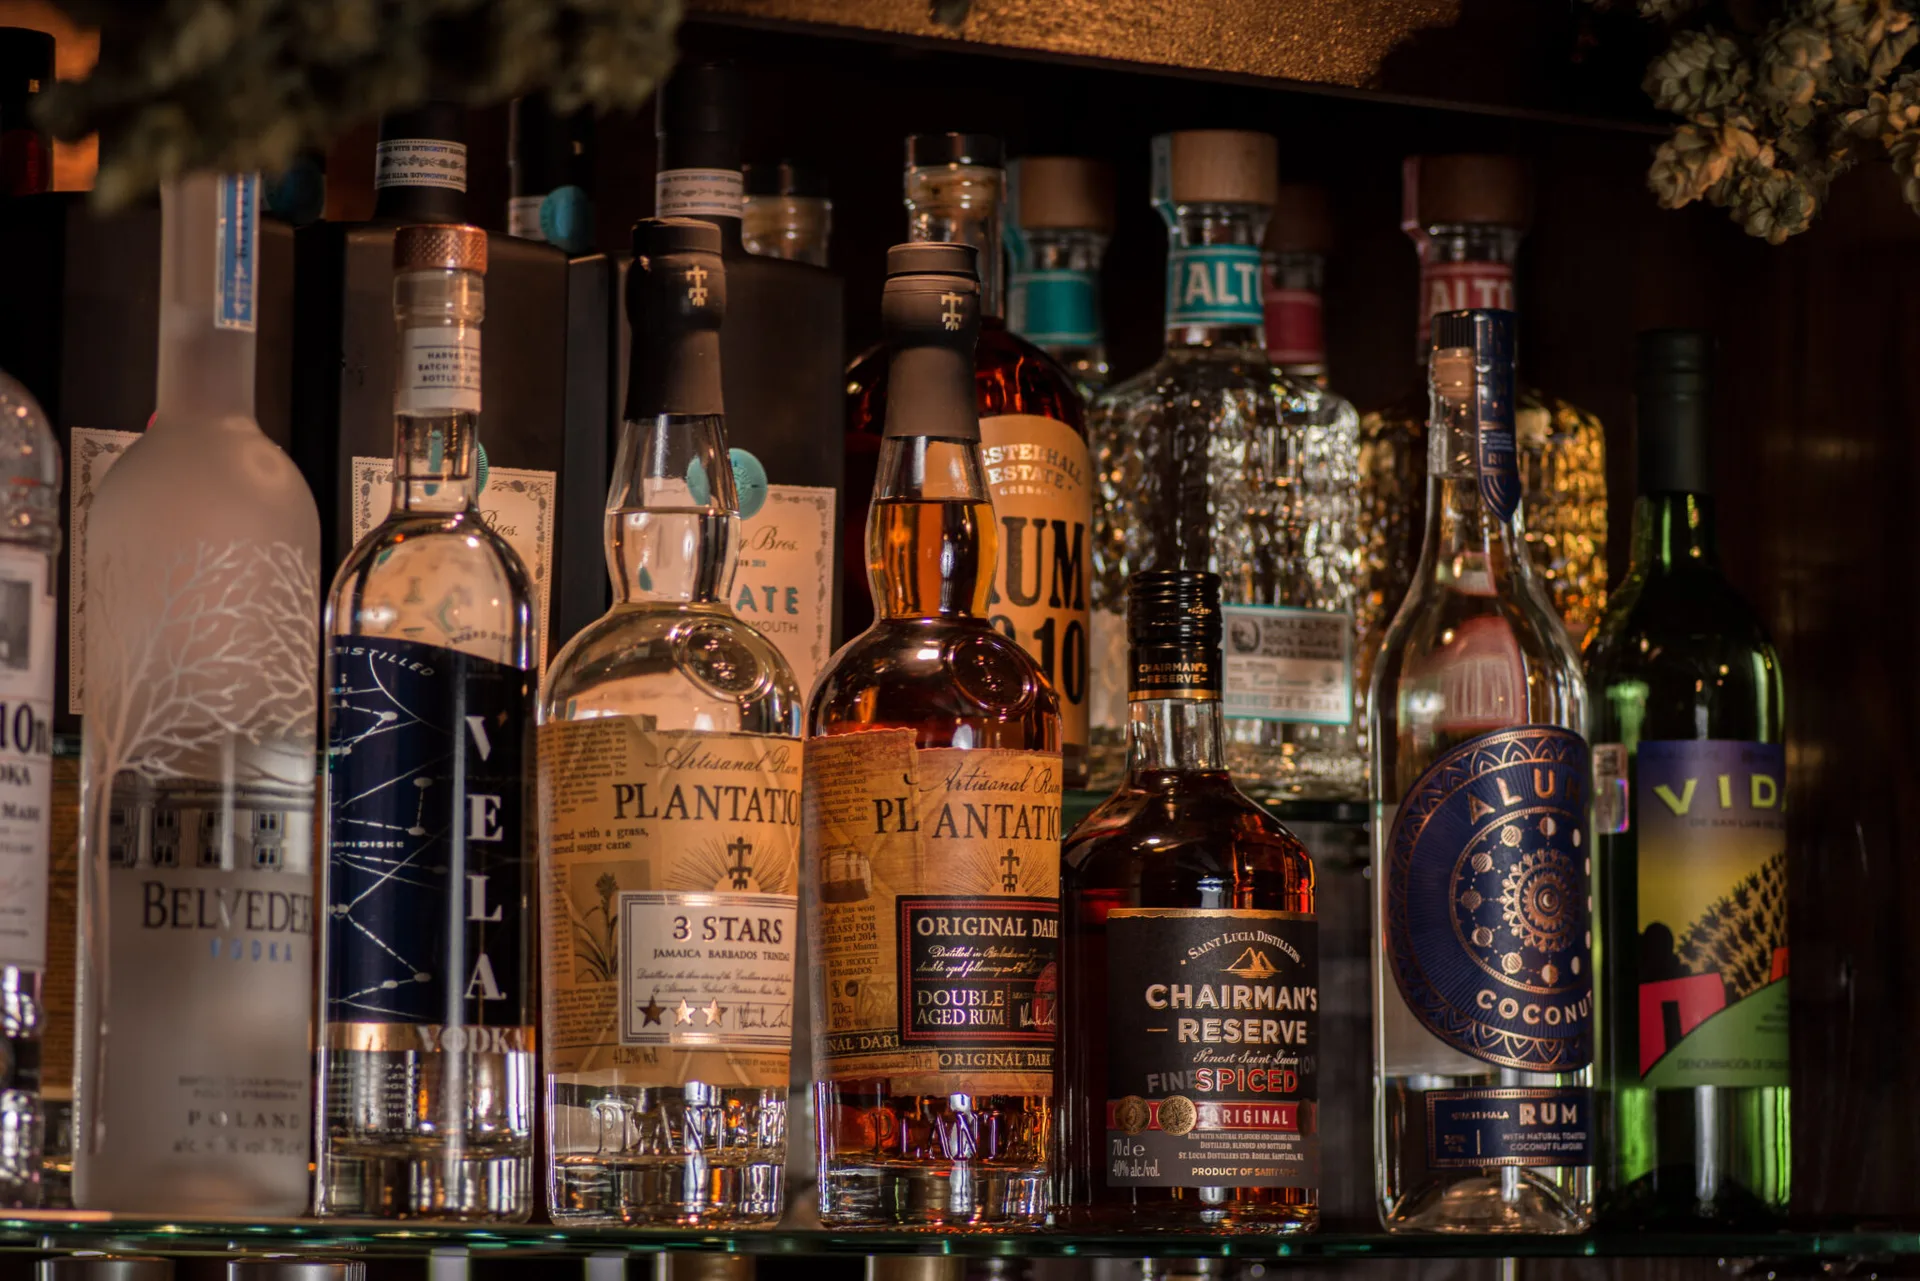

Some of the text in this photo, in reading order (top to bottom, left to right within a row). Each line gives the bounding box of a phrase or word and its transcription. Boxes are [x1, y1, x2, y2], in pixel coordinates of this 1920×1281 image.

[418, 363, 449, 372] BATCH
[752, 525, 799, 551] Bros.
[1138, 662, 1208, 674] CHAIRMAN'S
[645, 740, 768, 771] Artisanal
[903, 763, 1034, 793] Artisanal
[1653, 773, 1787, 816] VID
[579, 824, 600, 838] with
[605, 829, 612, 837] a
[617, 826, 649, 839] grass,
[606, 840, 631, 851] cane
[672, 915, 783, 945] 3 STARS
[856, 922, 876, 931] FOR
[917, 916, 1027, 938] ORIGINAL
[858, 932, 876, 940] 2014
[210, 936, 293, 962] VODKA
[653, 948, 758, 961] JAMAICA BARBADOS
[928, 944, 972, 959] Distilled
[1187, 930, 1301, 964] SAINT LUCIA DISTILLERS
[917, 989, 1004, 1007] DOUBLE
[1145, 984, 1318, 1012] CHAIRMAN'S
[833, 1016, 851, 1029] 40%
[916, 1008, 967, 1025] AGED
[969, 1008, 1005, 1025] RUM
[1178, 1018, 1308, 1045] RESERVE
[938, 1052, 1023, 1068] ORIGINAL
[1193, 1046, 1300, 1065] Finest Saint Lucia
[1194, 1067, 1298, 1093] SPICED
[1519, 1102, 1578, 1126] RUM
[1200, 1141, 1232, 1150] DISTILLED,
[1502, 1132, 1525, 1141] WITH
[1526, 1132, 1561, 1141] NATURAL
[1112, 1138, 1121, 1156] 70
[1188, 1151, 1206, 1160] LUCIA
[1207, 1151, 1239, 1160] DISTILLERS
[1112, 1158, 1129, 1178] 40%
[1191, 1167, 1238, 1176] PRODUCT
[1240, 1167, 1254, 1177] OF
